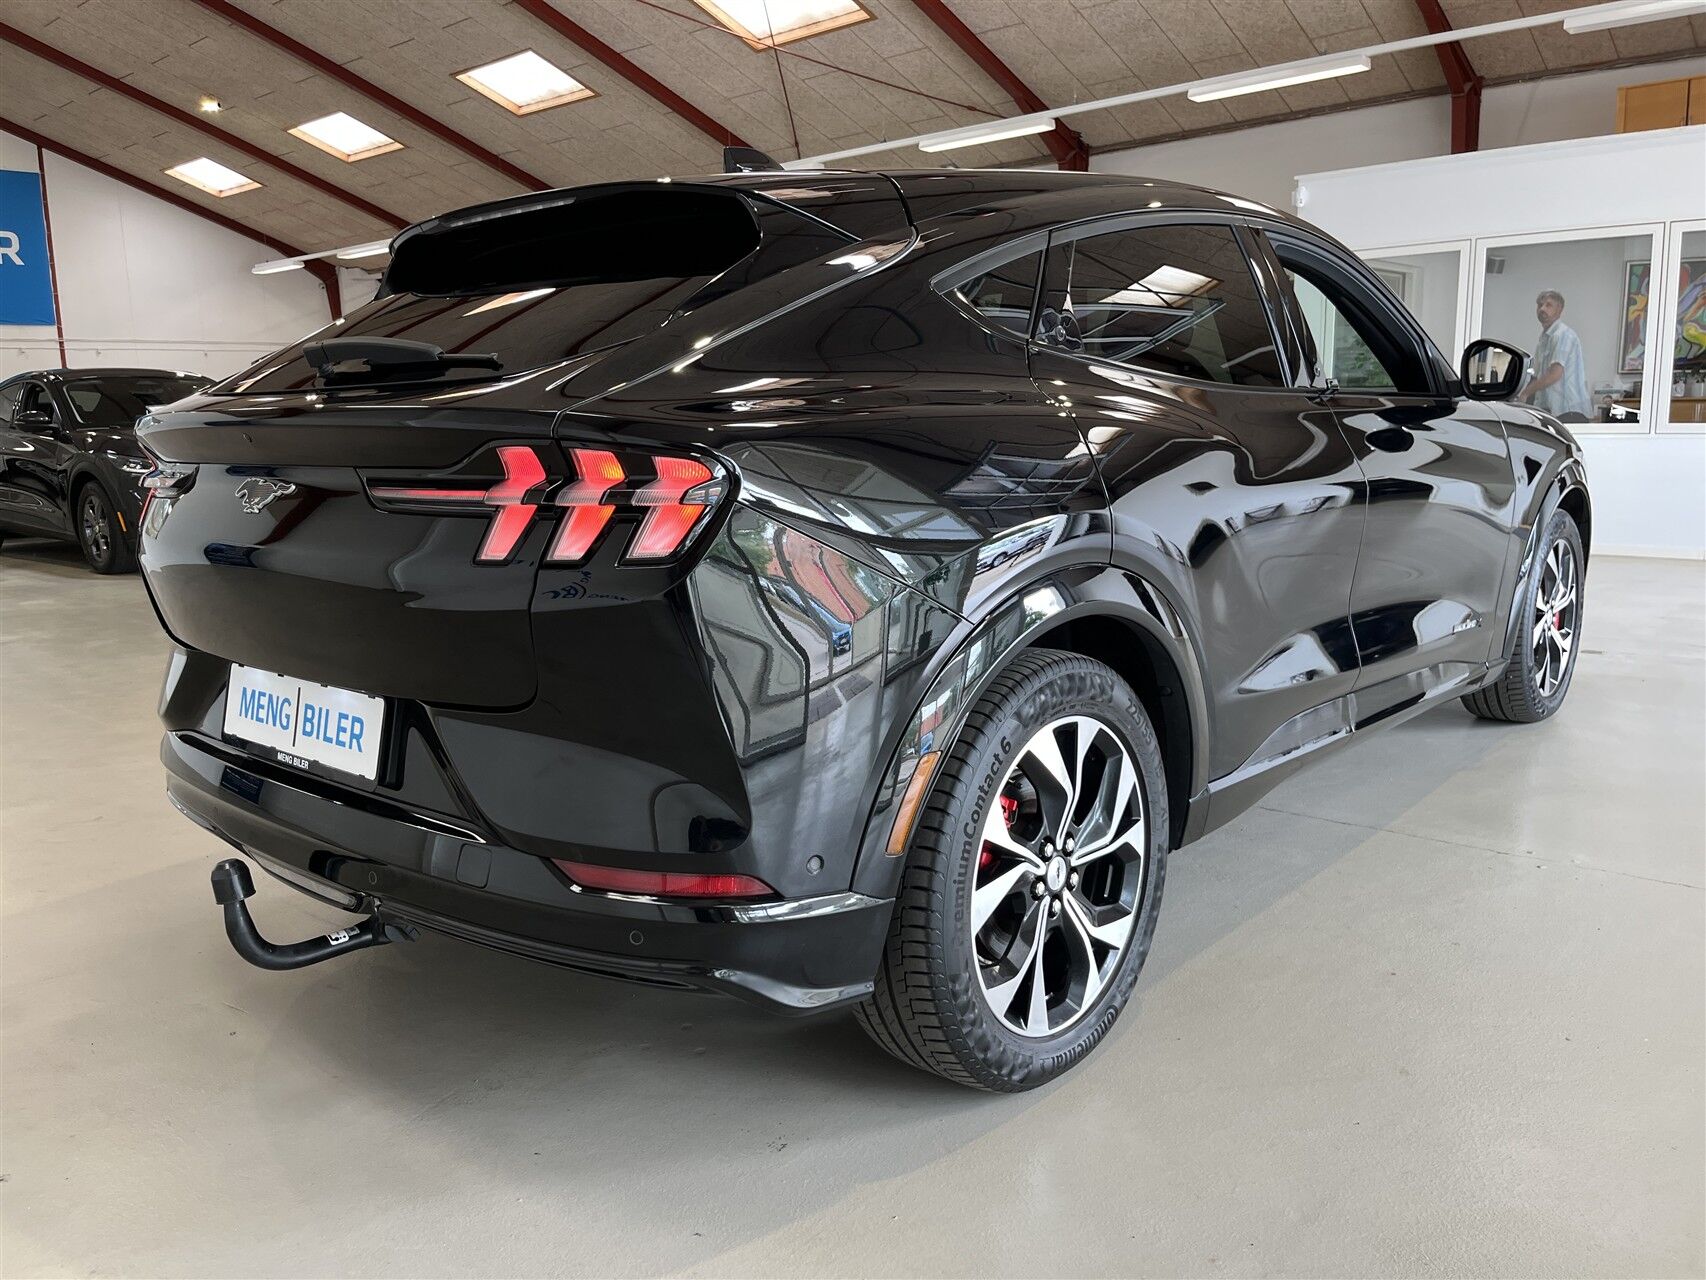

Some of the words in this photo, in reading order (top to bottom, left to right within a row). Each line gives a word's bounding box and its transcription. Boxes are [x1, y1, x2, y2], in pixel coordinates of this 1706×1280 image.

[239, 686, 292, 731] MENG
[302, 703, 365, 753] BILER
[1000, 735, 1012, 755] 6
[277, 751, 294, 765] MENG
[293, 757, 309, 770] BILER
